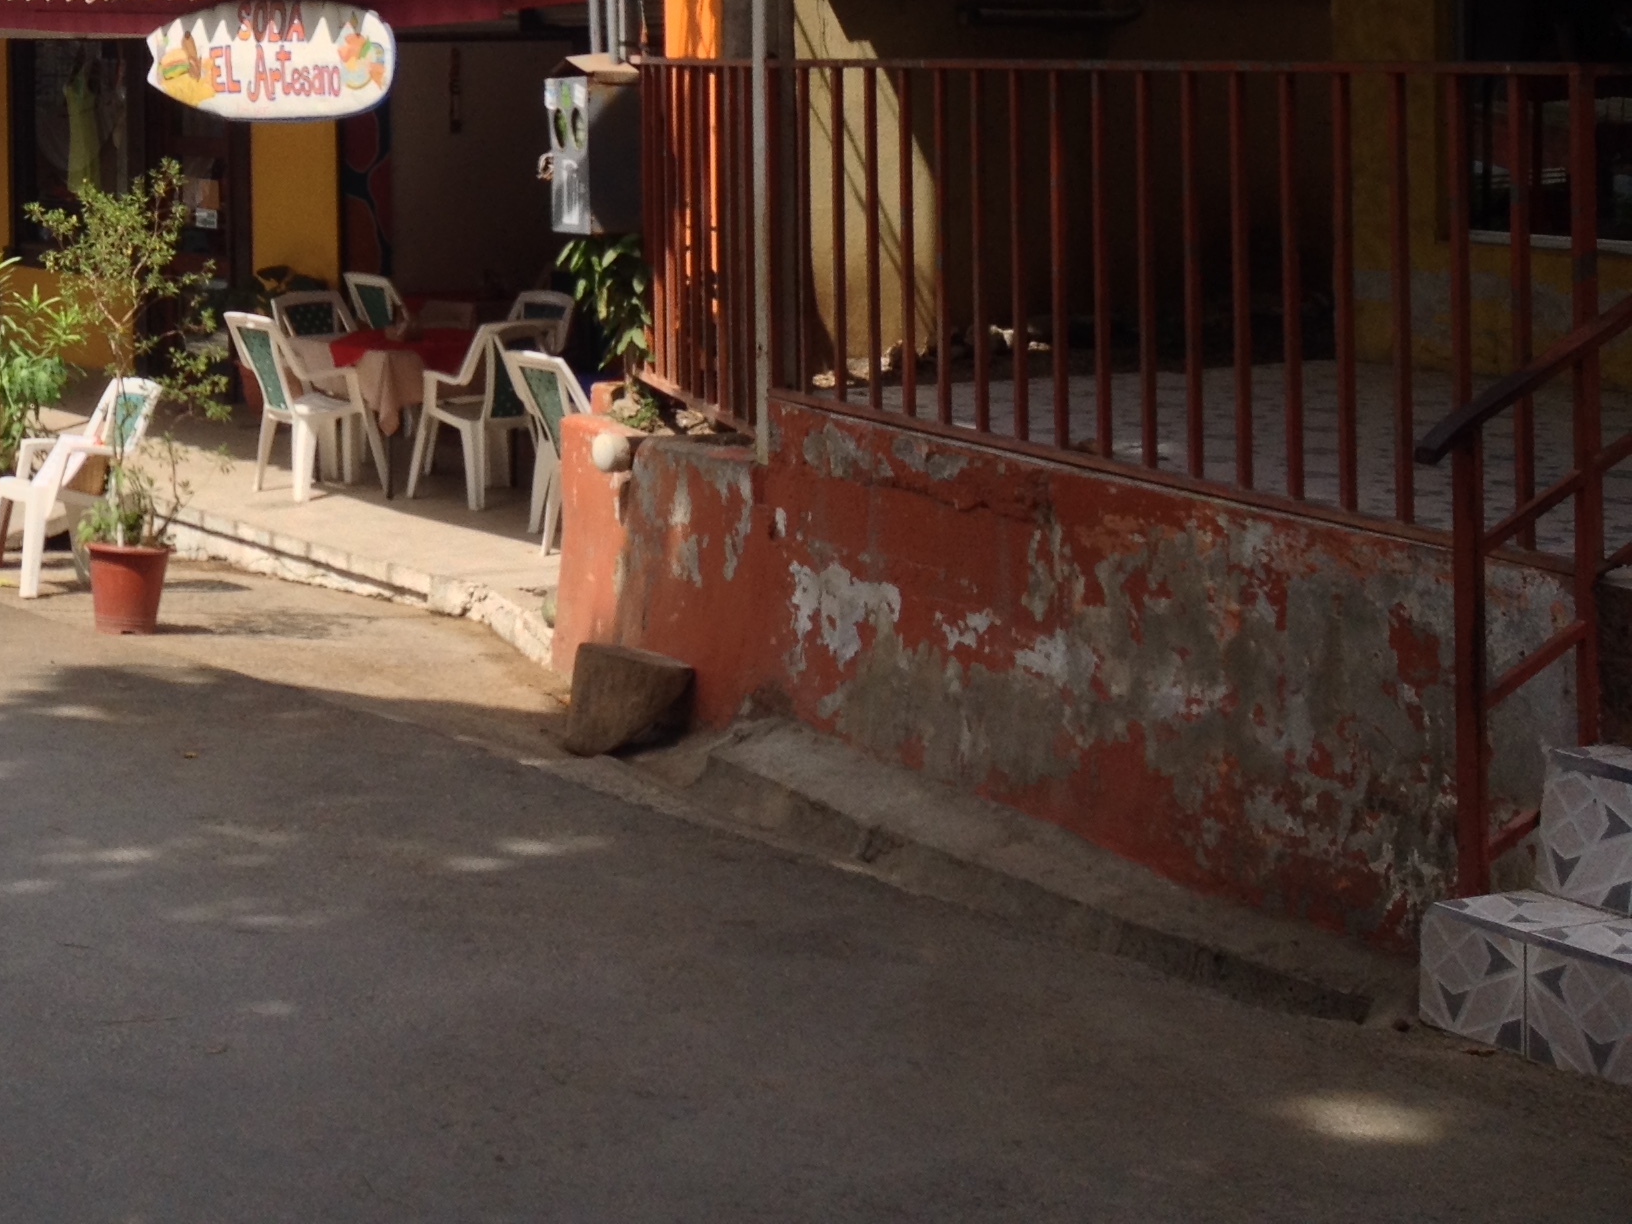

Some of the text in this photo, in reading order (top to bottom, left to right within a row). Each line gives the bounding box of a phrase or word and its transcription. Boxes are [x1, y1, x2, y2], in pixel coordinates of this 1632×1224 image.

[236, 0, 306, 43] SODA
[208, 44, 341, 103] EL Artesano
